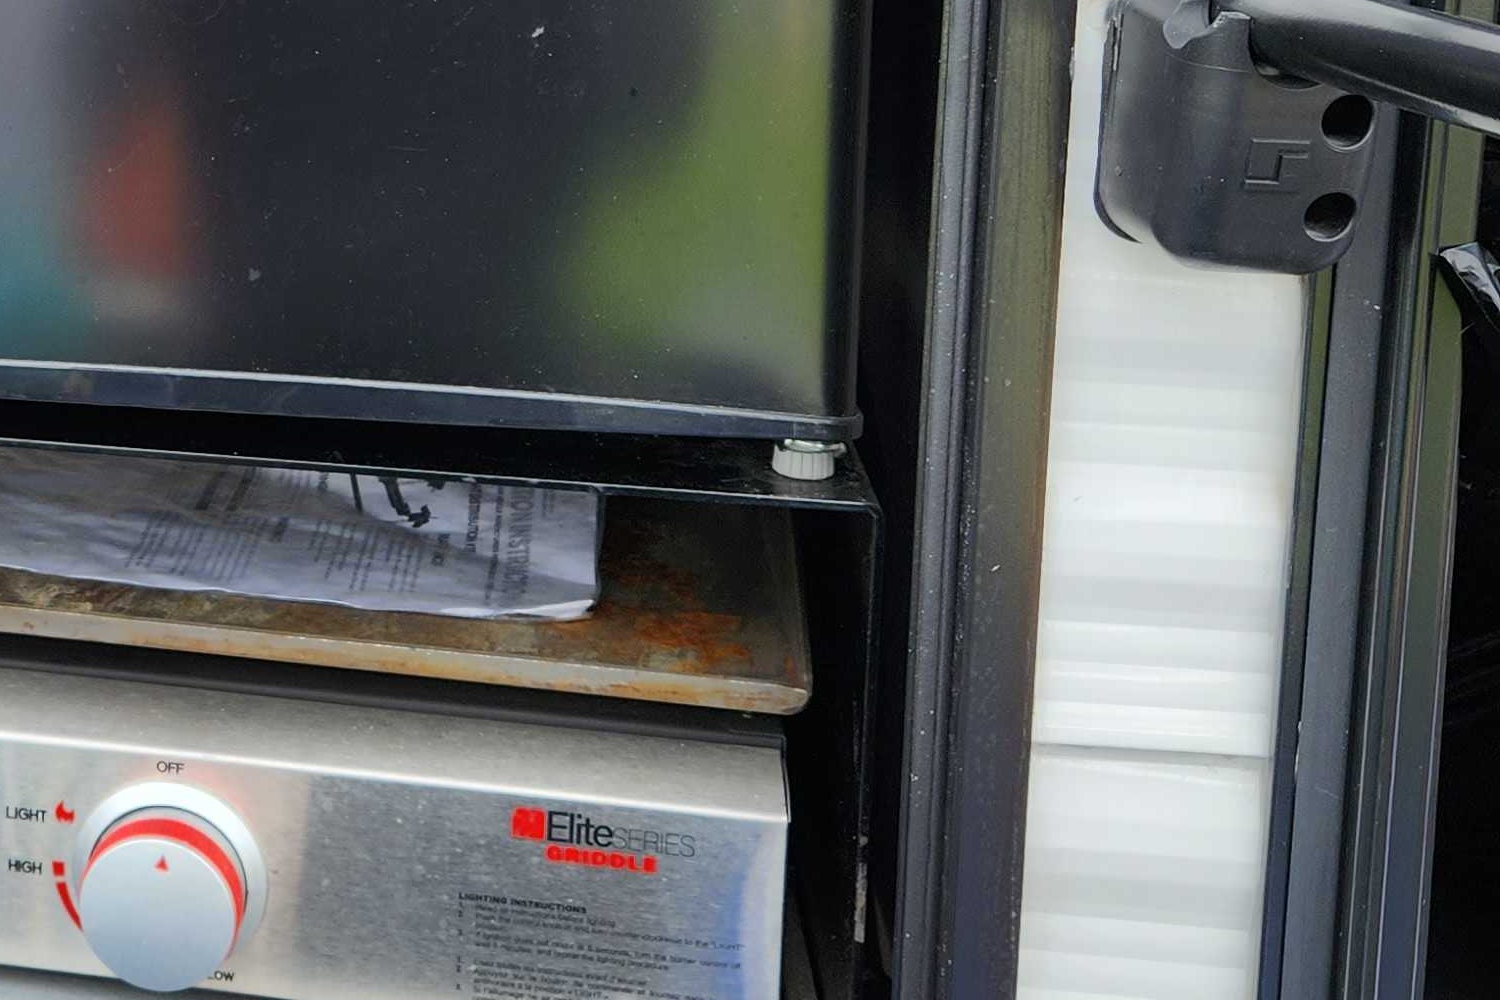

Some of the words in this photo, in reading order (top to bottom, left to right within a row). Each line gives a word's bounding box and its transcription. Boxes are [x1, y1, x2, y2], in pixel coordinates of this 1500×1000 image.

[157, 761, 184, 774] OFF
[5, 806, 47, 823] LIGHT
[8, 858, 43, 875] HIGH
[545, 844, 658, 873] GRIDDLE
[459, 892, 507, 904] LIGHTING
[510, 899, 586, 913] INSTRUCTIONS
